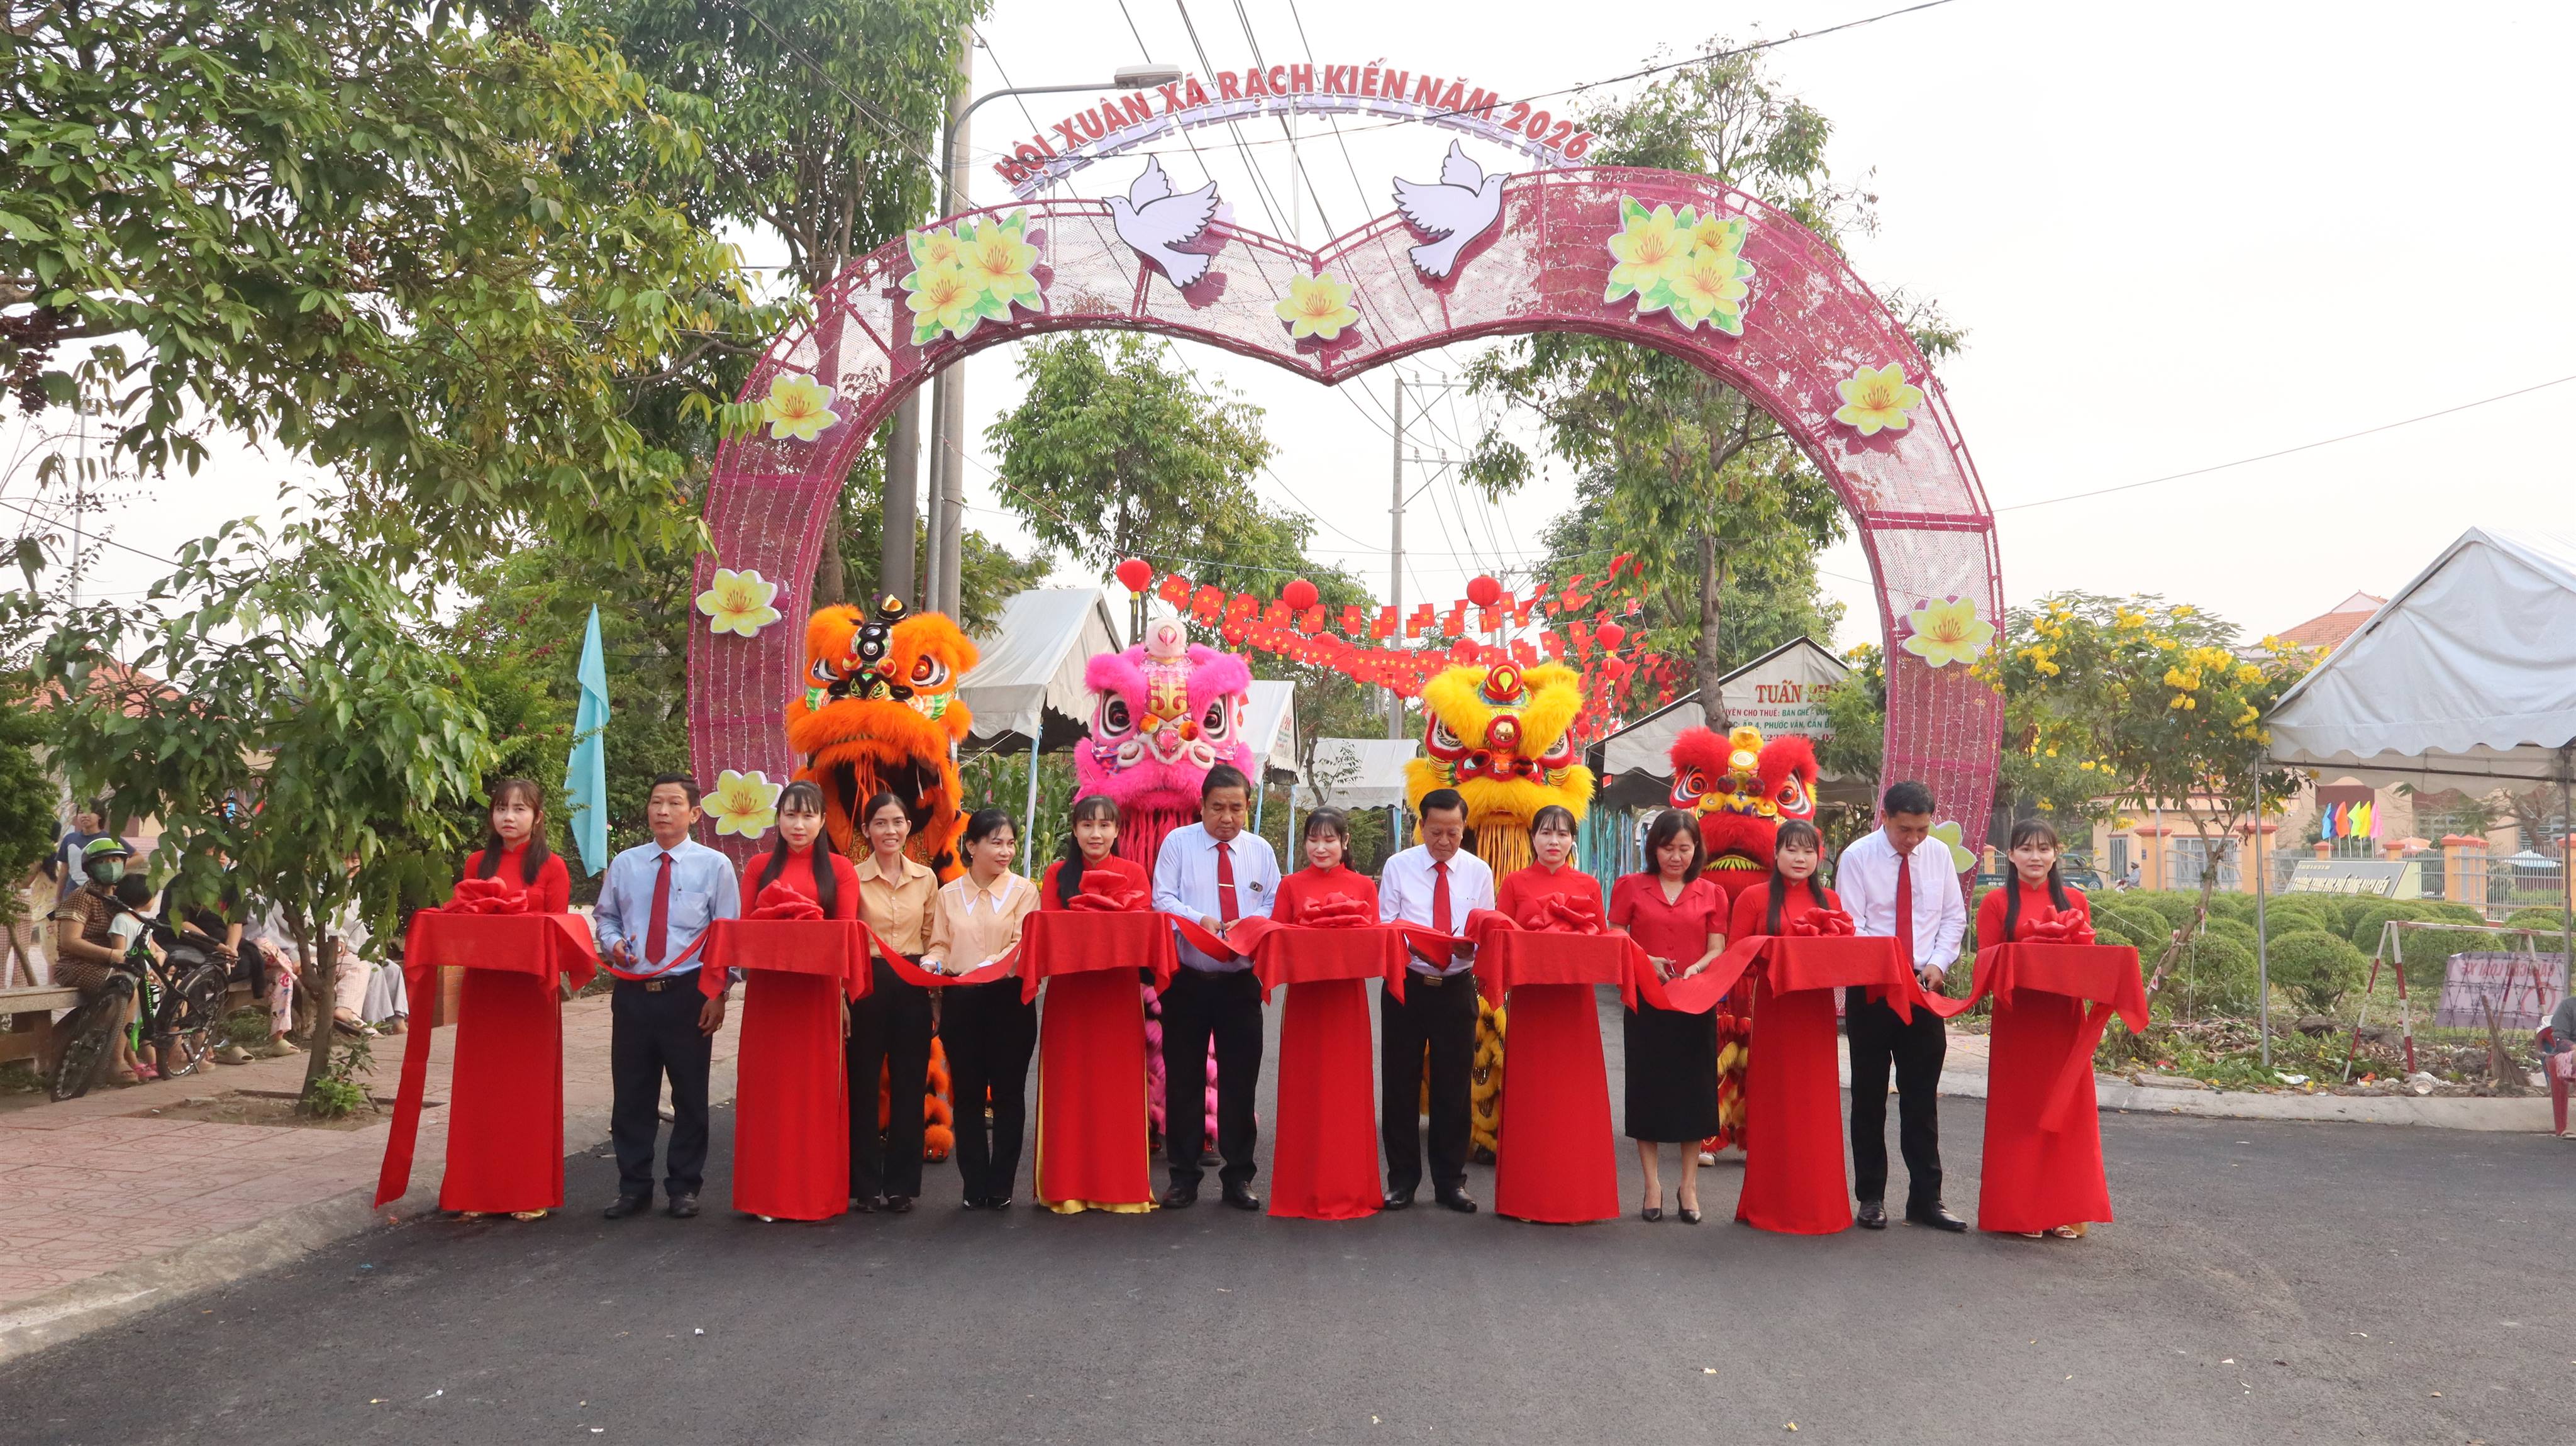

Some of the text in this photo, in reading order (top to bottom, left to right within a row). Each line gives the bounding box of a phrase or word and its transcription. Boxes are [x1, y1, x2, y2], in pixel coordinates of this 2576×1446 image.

[992, 57, 1597, 187] HỘI XUÂN XÃ RẠCH KIẾN NĂM 2026
[1755, 679, 1803, 704] TUẤN
[1743, 709, 1758, 717] CHO
